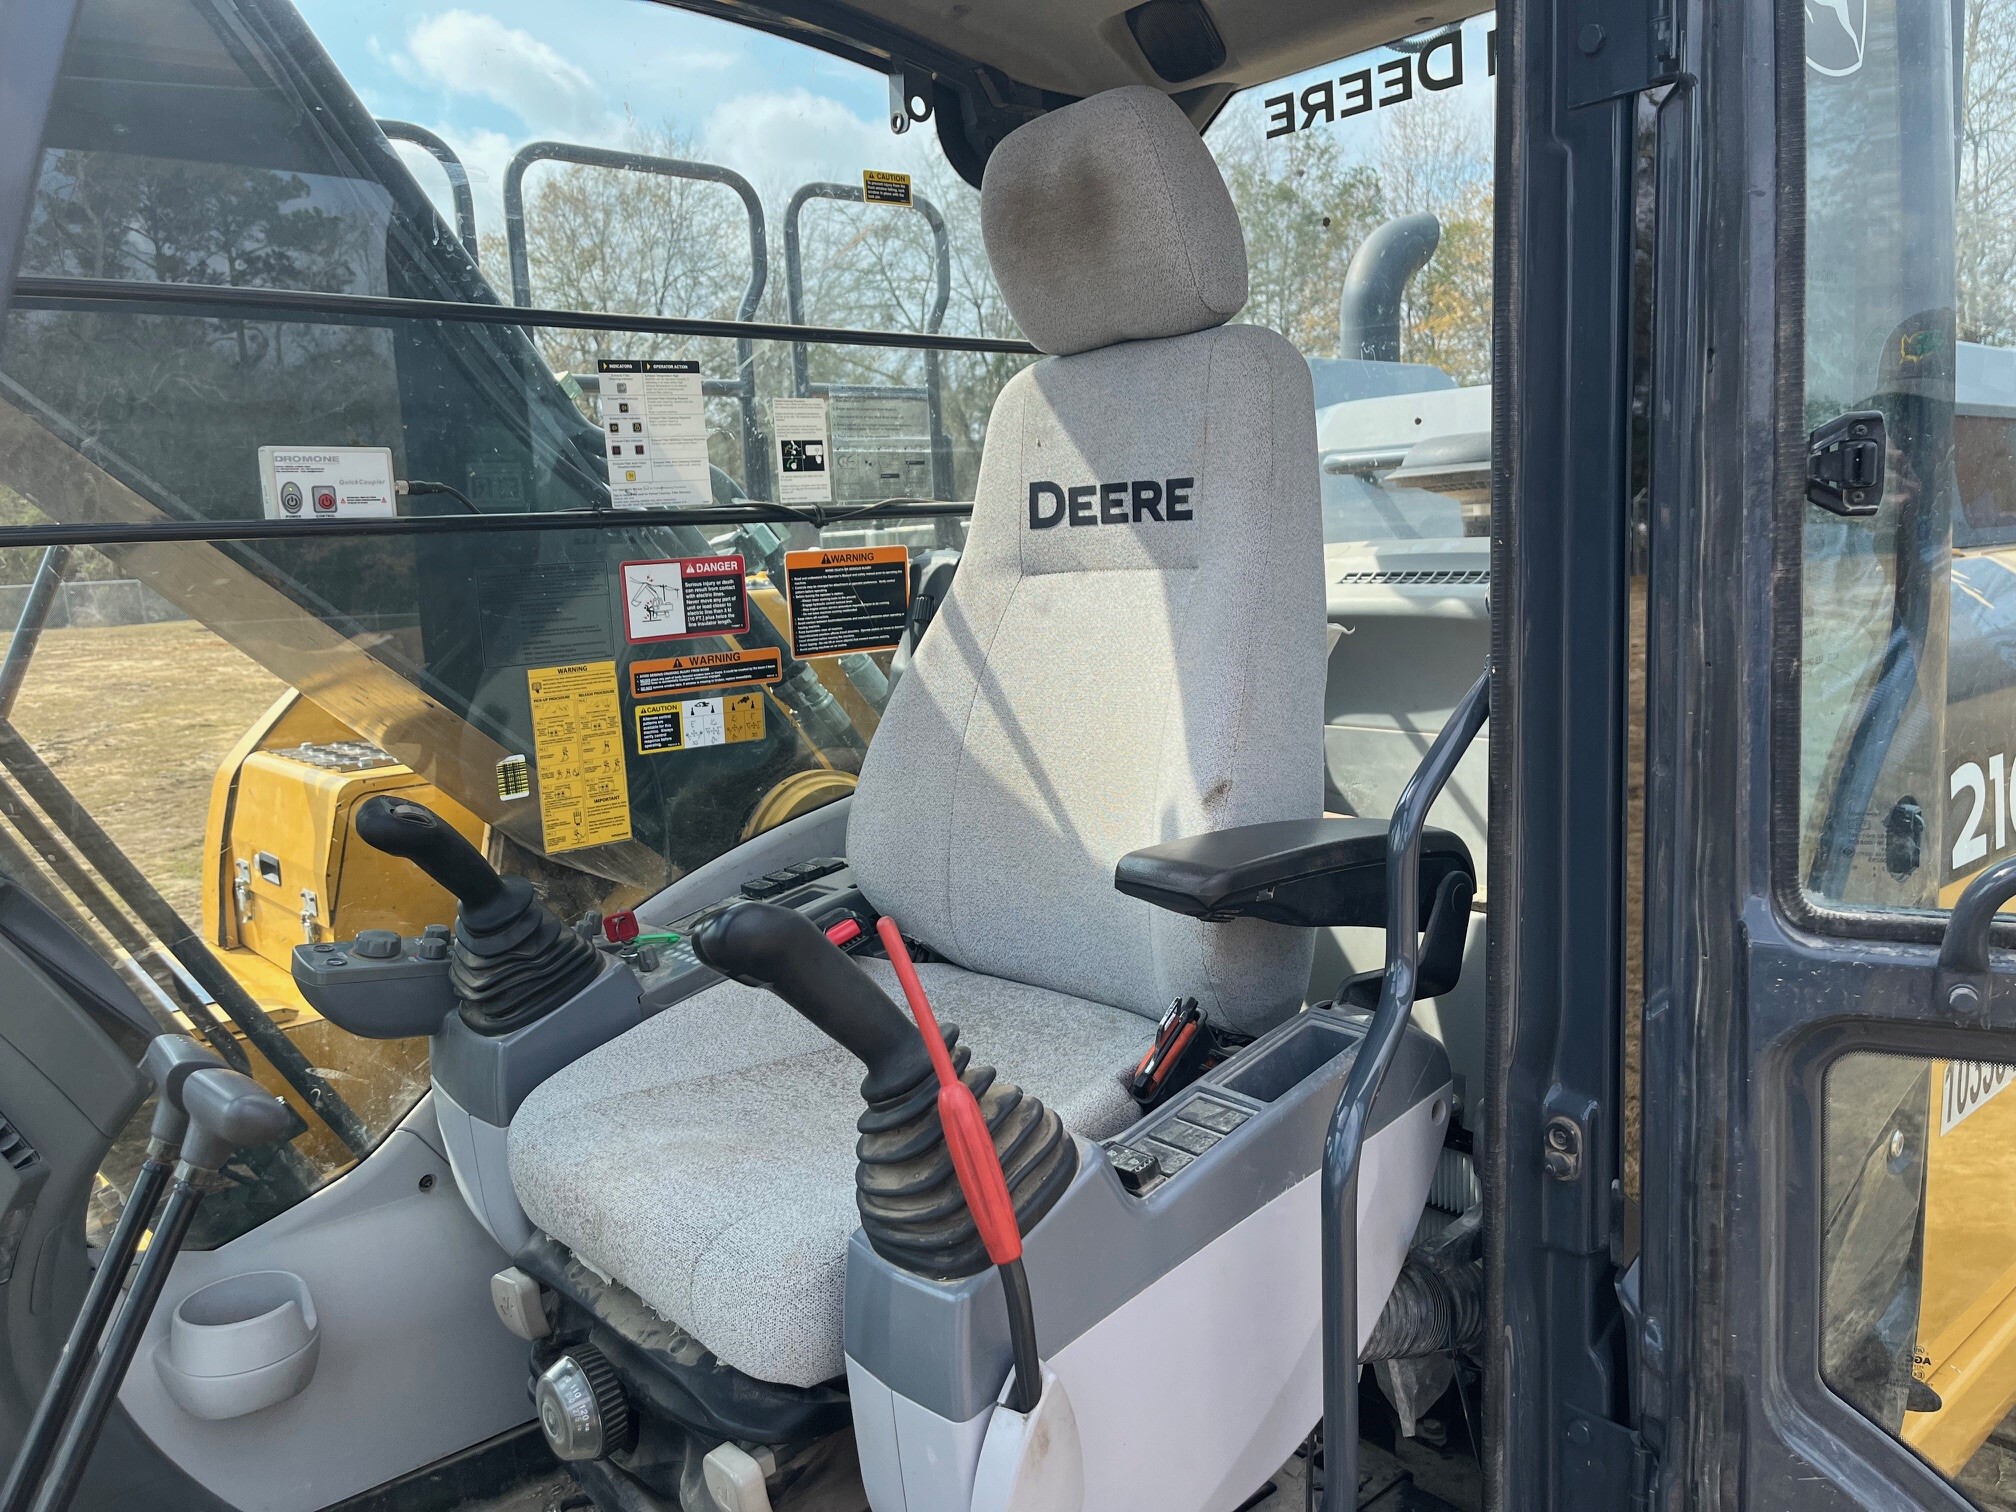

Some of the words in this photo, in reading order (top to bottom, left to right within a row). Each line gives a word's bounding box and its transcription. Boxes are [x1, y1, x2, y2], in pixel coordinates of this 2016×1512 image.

[877, 173, 905, 182] CAUTION
[275, 455, 340, 463] DROMONE
[1029, 477, 1195, 530] DEERE
[831, 552, 875, 564] WARNING
[696, 561, 738, 573] DANGER
[689, 652, 741, 667] WARNING
[557, 665, 588, 674] WARNING
[647, 705, 678, 713] CAUTION
[593, 795, 620, 804] IMPORTANT
[1951, 753, 2016, 870] 21
[570, 1384, 582, 1398] 110
[580, 1404, 590, 1421] 120
